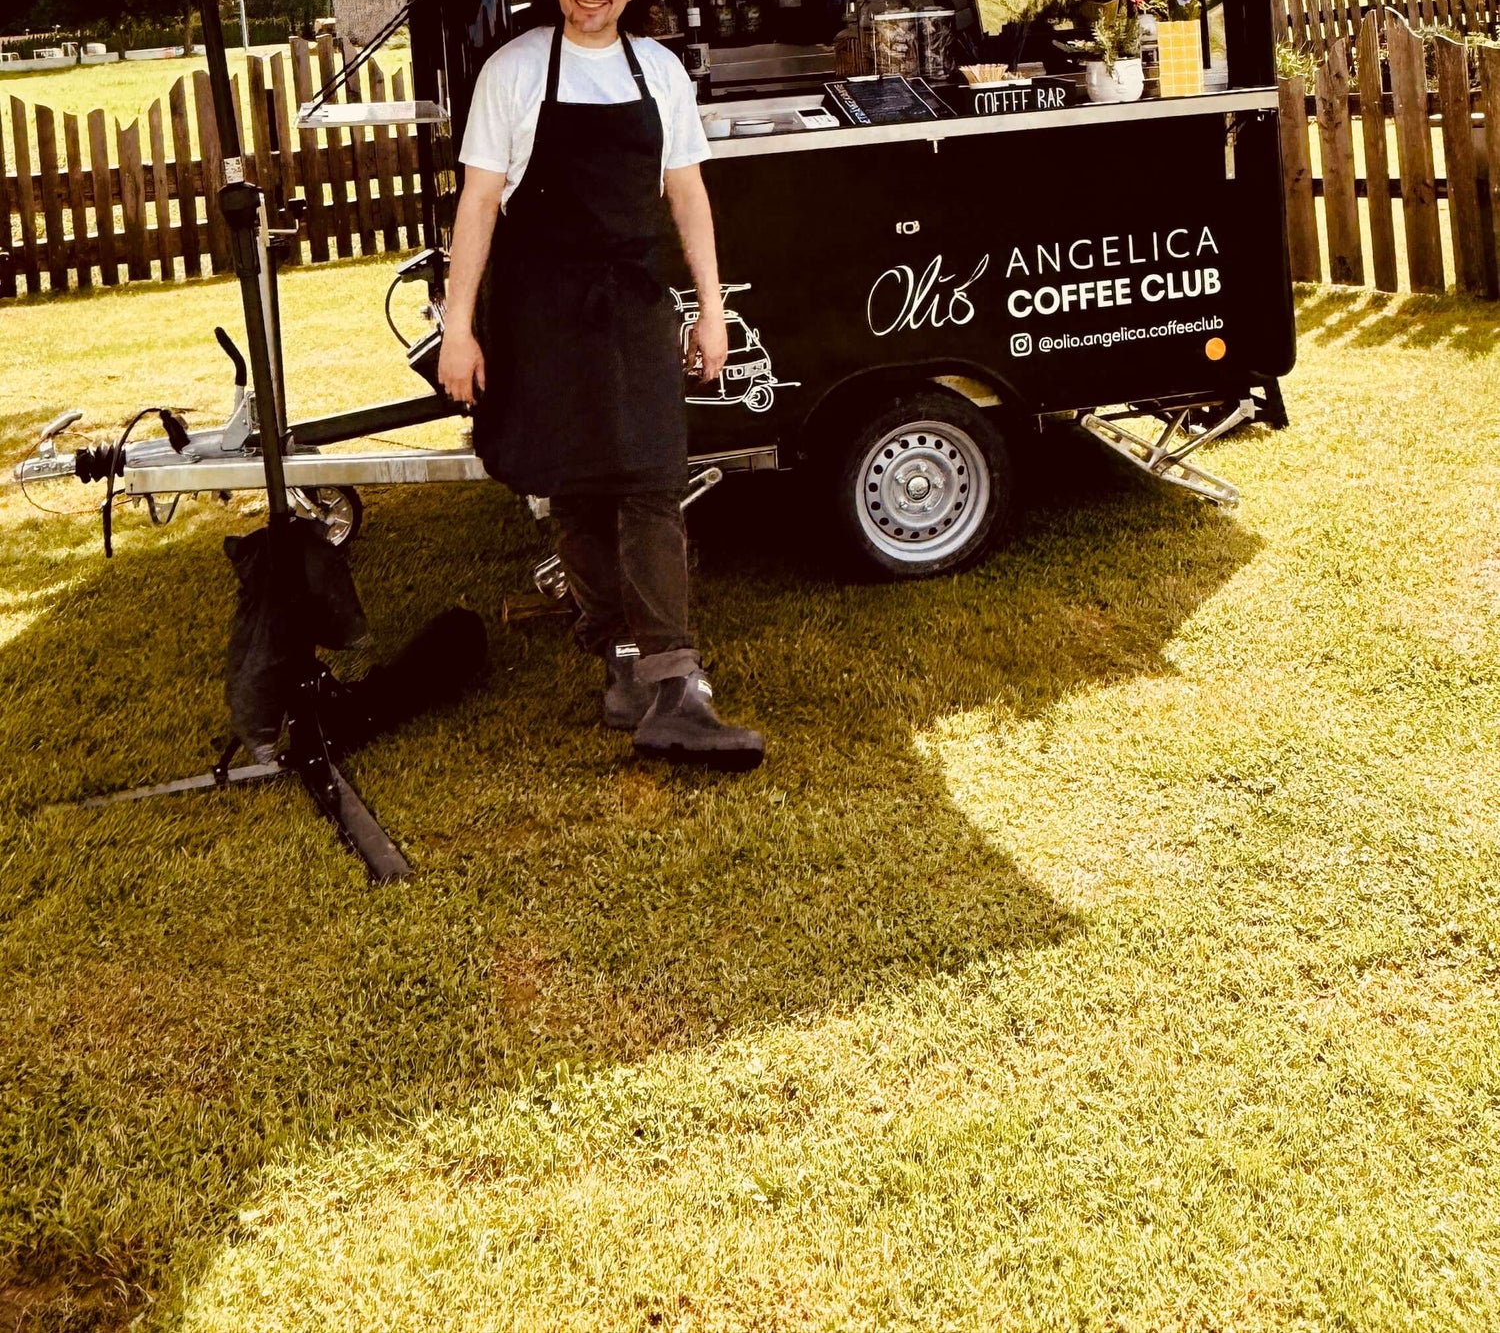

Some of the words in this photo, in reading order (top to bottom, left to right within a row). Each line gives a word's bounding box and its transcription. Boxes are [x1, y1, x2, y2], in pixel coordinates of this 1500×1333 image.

[1037, 87, 1066, 109] BAR
[1005, 226, 1219, 278] ANGELICA
[1007, 278, 1132, 319] COFFEE
[1140, 268, 1222, 302] CLUB
[1038, 315, 1224, 353] @olio.angelica.coffeeclub
